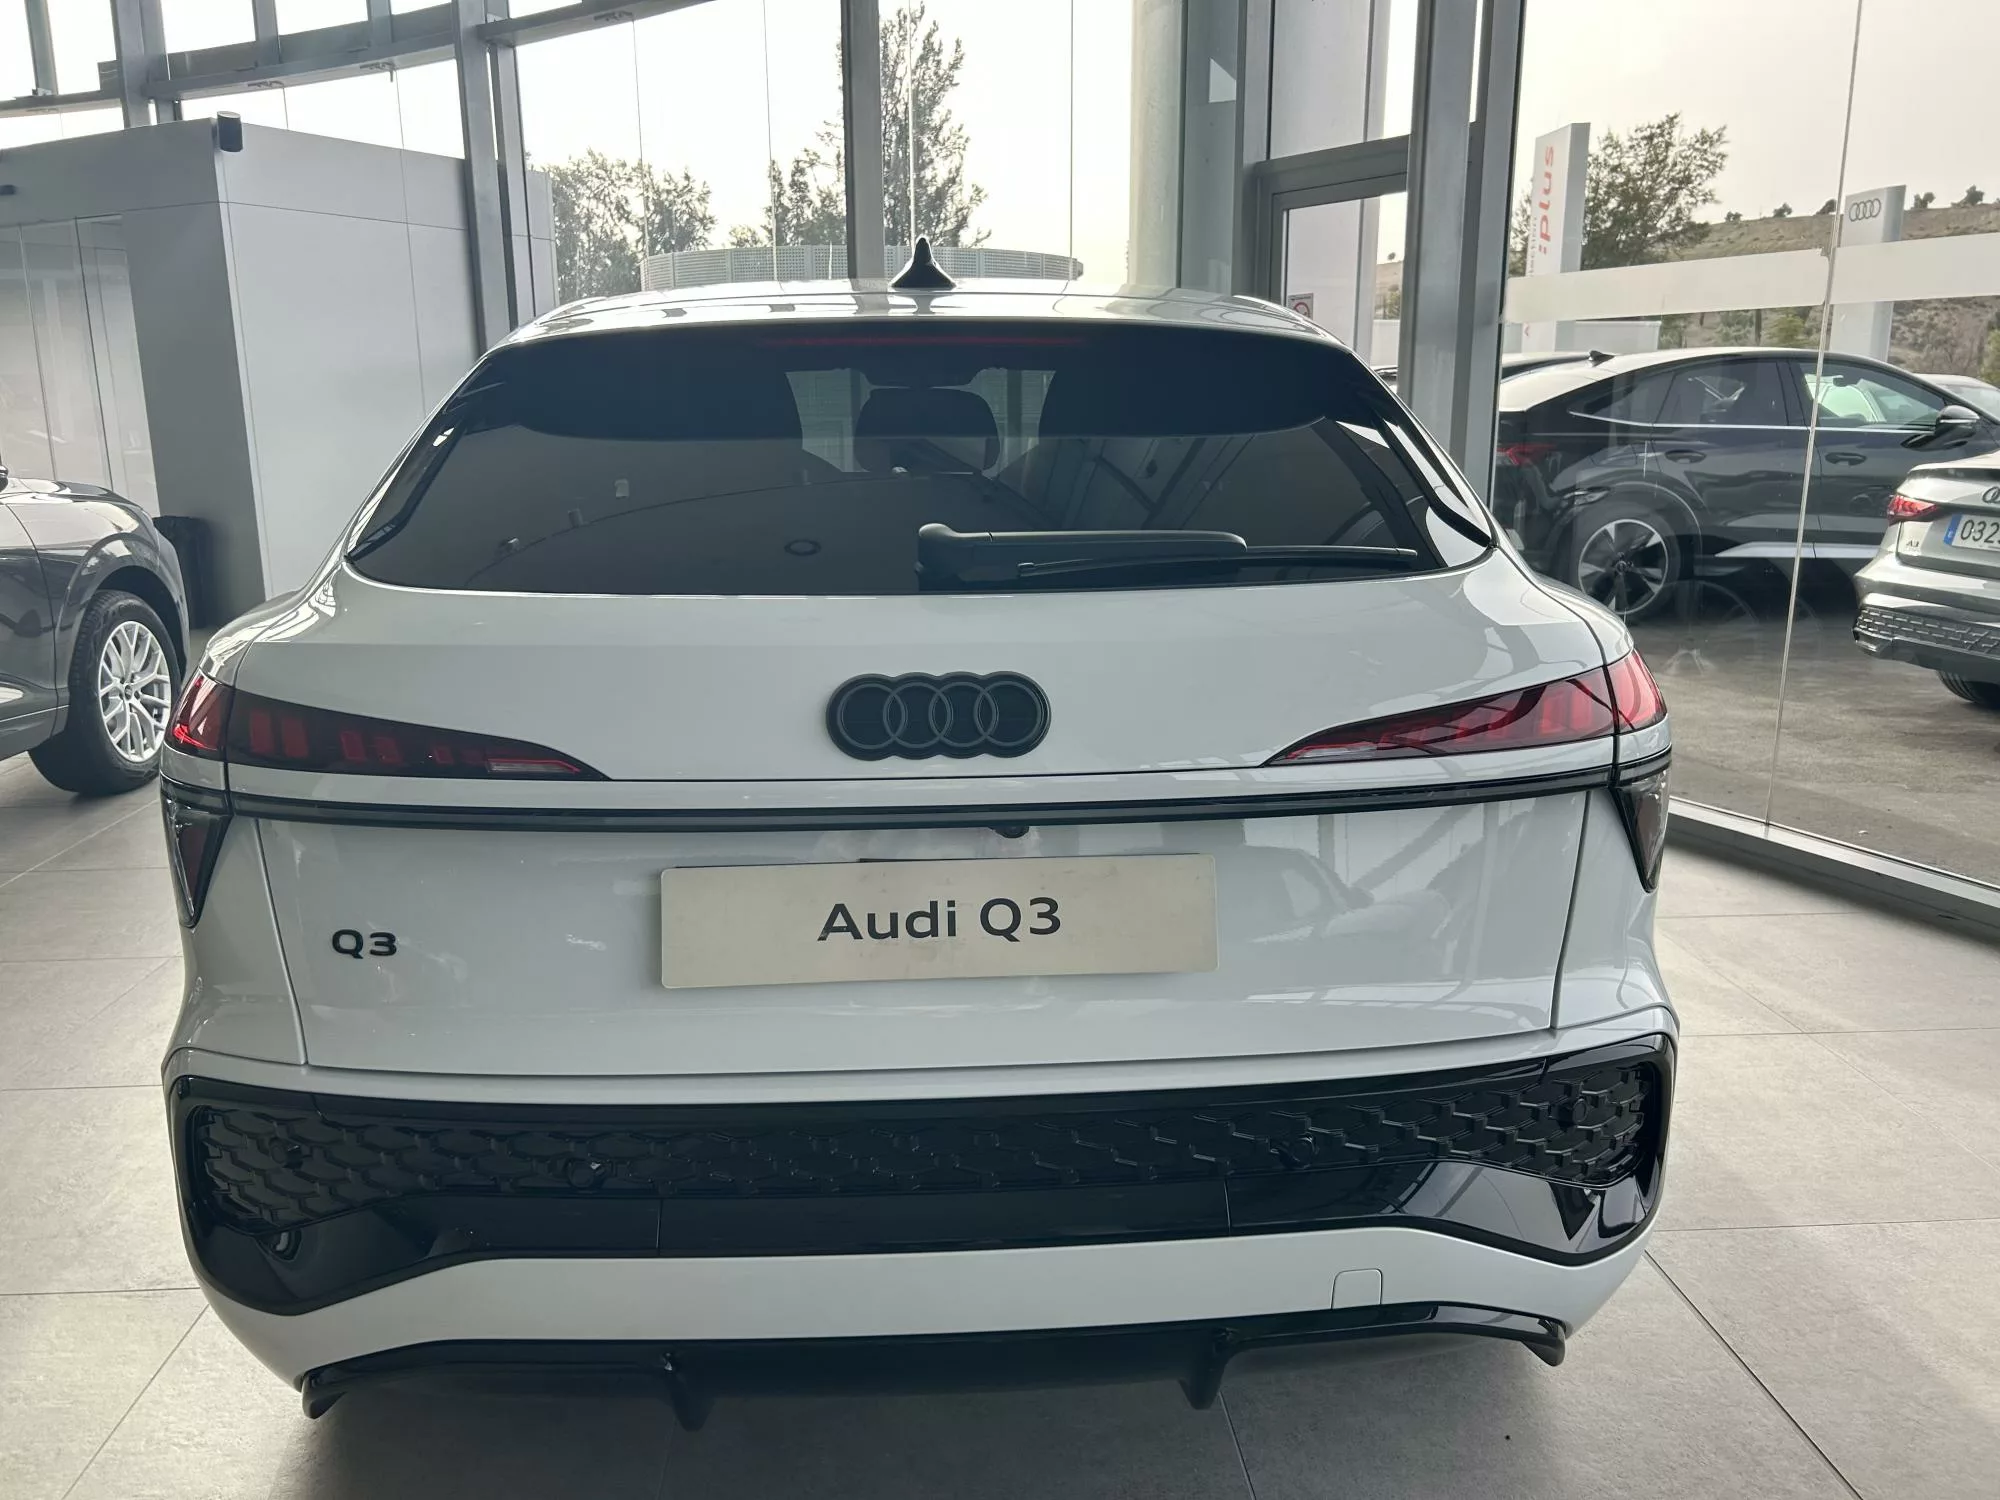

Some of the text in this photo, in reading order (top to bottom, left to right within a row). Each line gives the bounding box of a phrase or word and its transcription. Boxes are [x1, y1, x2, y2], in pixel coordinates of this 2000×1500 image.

[1960, 519, 2000, 544] 032
[817, 896, 1062, 943] Audi Q3
[331, 929, 397, 960] Q3
